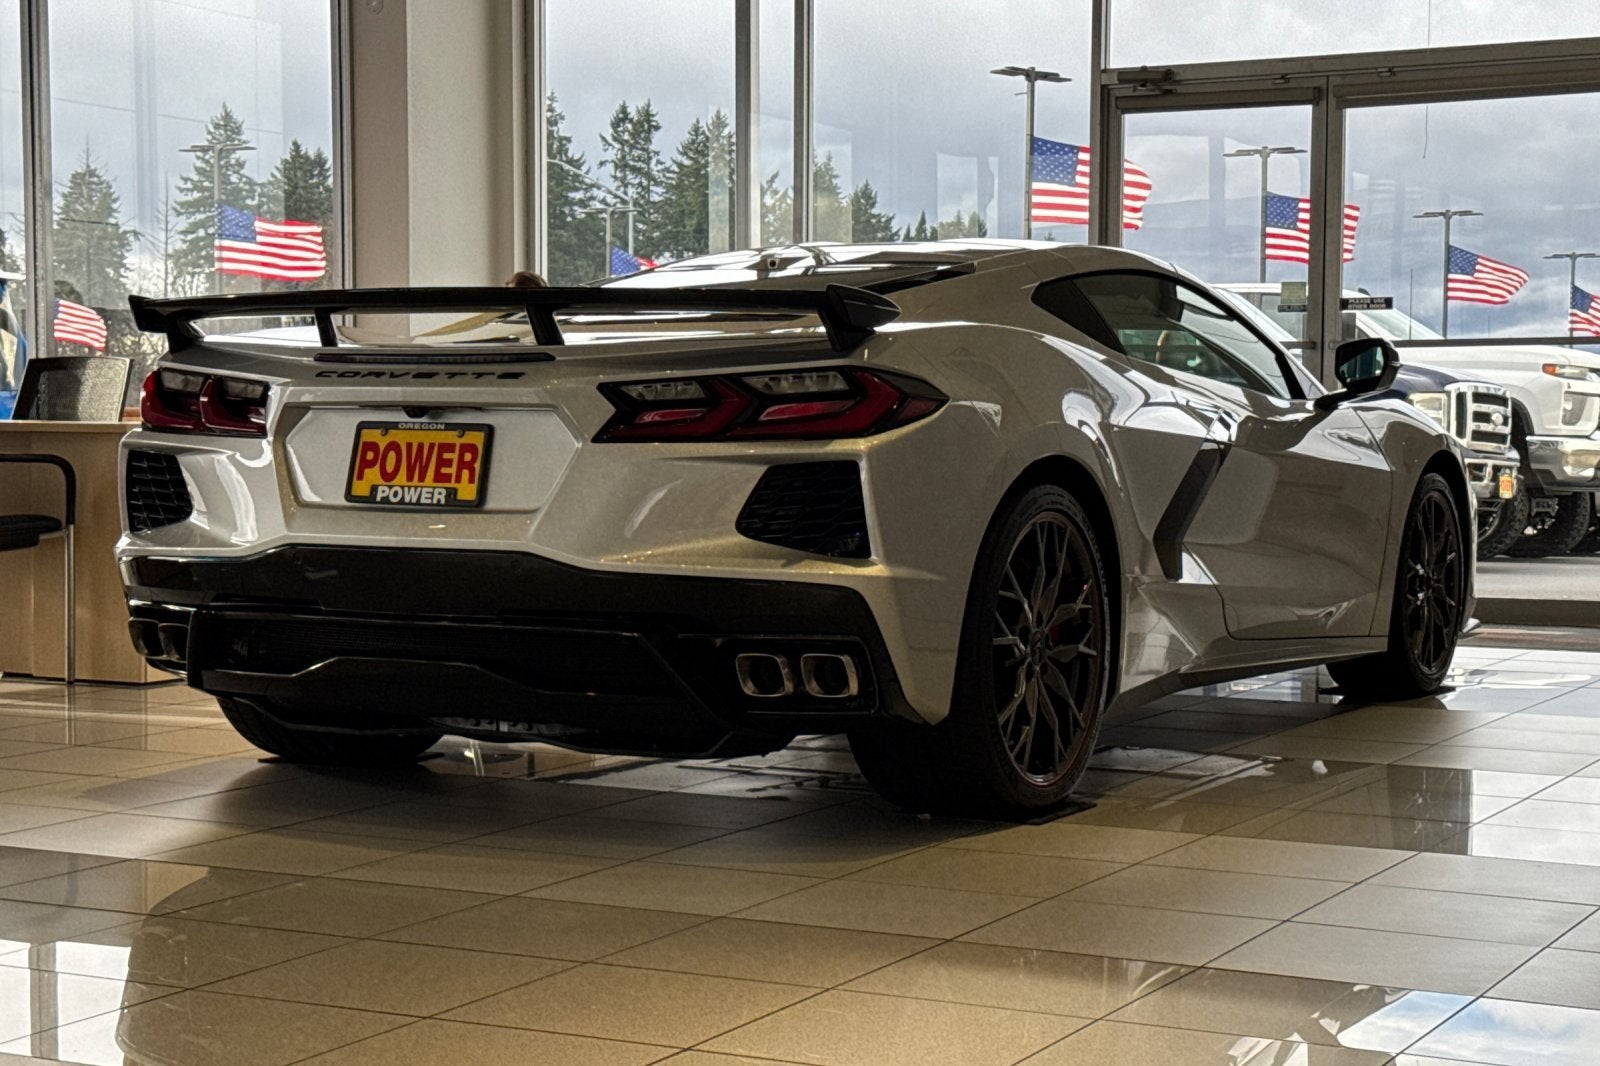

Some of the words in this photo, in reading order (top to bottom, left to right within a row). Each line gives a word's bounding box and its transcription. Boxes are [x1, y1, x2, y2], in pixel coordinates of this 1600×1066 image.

[315, 370, 526, 380] CORVETTE
[398, 422, 446, 430] OREGON
[356, 440, 479, 484] POWER
[375, 486, 447, 504] POWER
